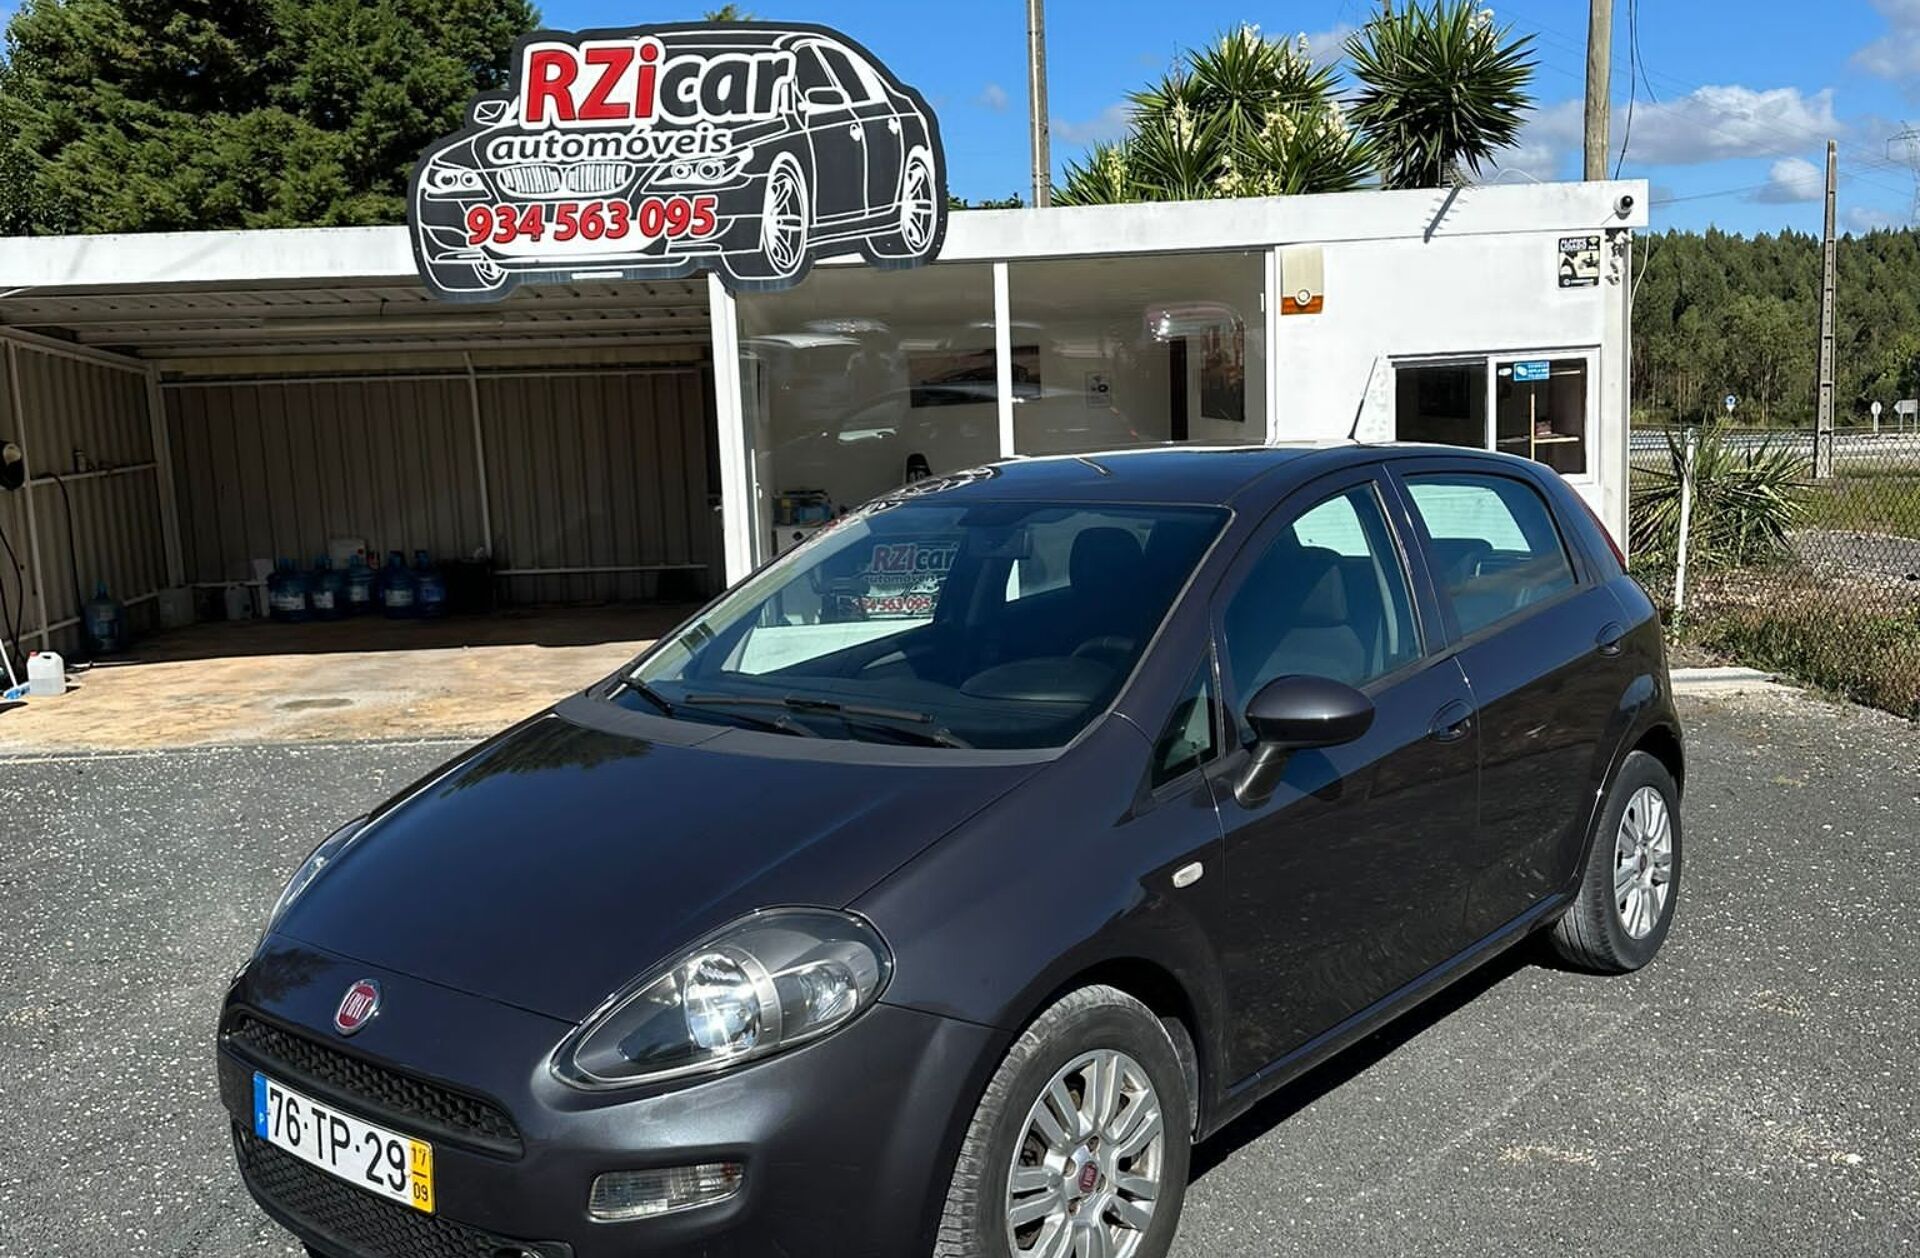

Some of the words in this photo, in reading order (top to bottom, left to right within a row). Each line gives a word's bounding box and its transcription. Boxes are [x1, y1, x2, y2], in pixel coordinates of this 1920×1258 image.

[525, 43, 790, 122] RZicar
[491, 125, 728, 160] automóveis
[467, 206, 544, 244] 934
[553, 202, 631, 241] 563
[639, 197, 716, 237] 095
[411, 1147, 427, 1168] 17
[412, 1182, 428, 1202] 09
